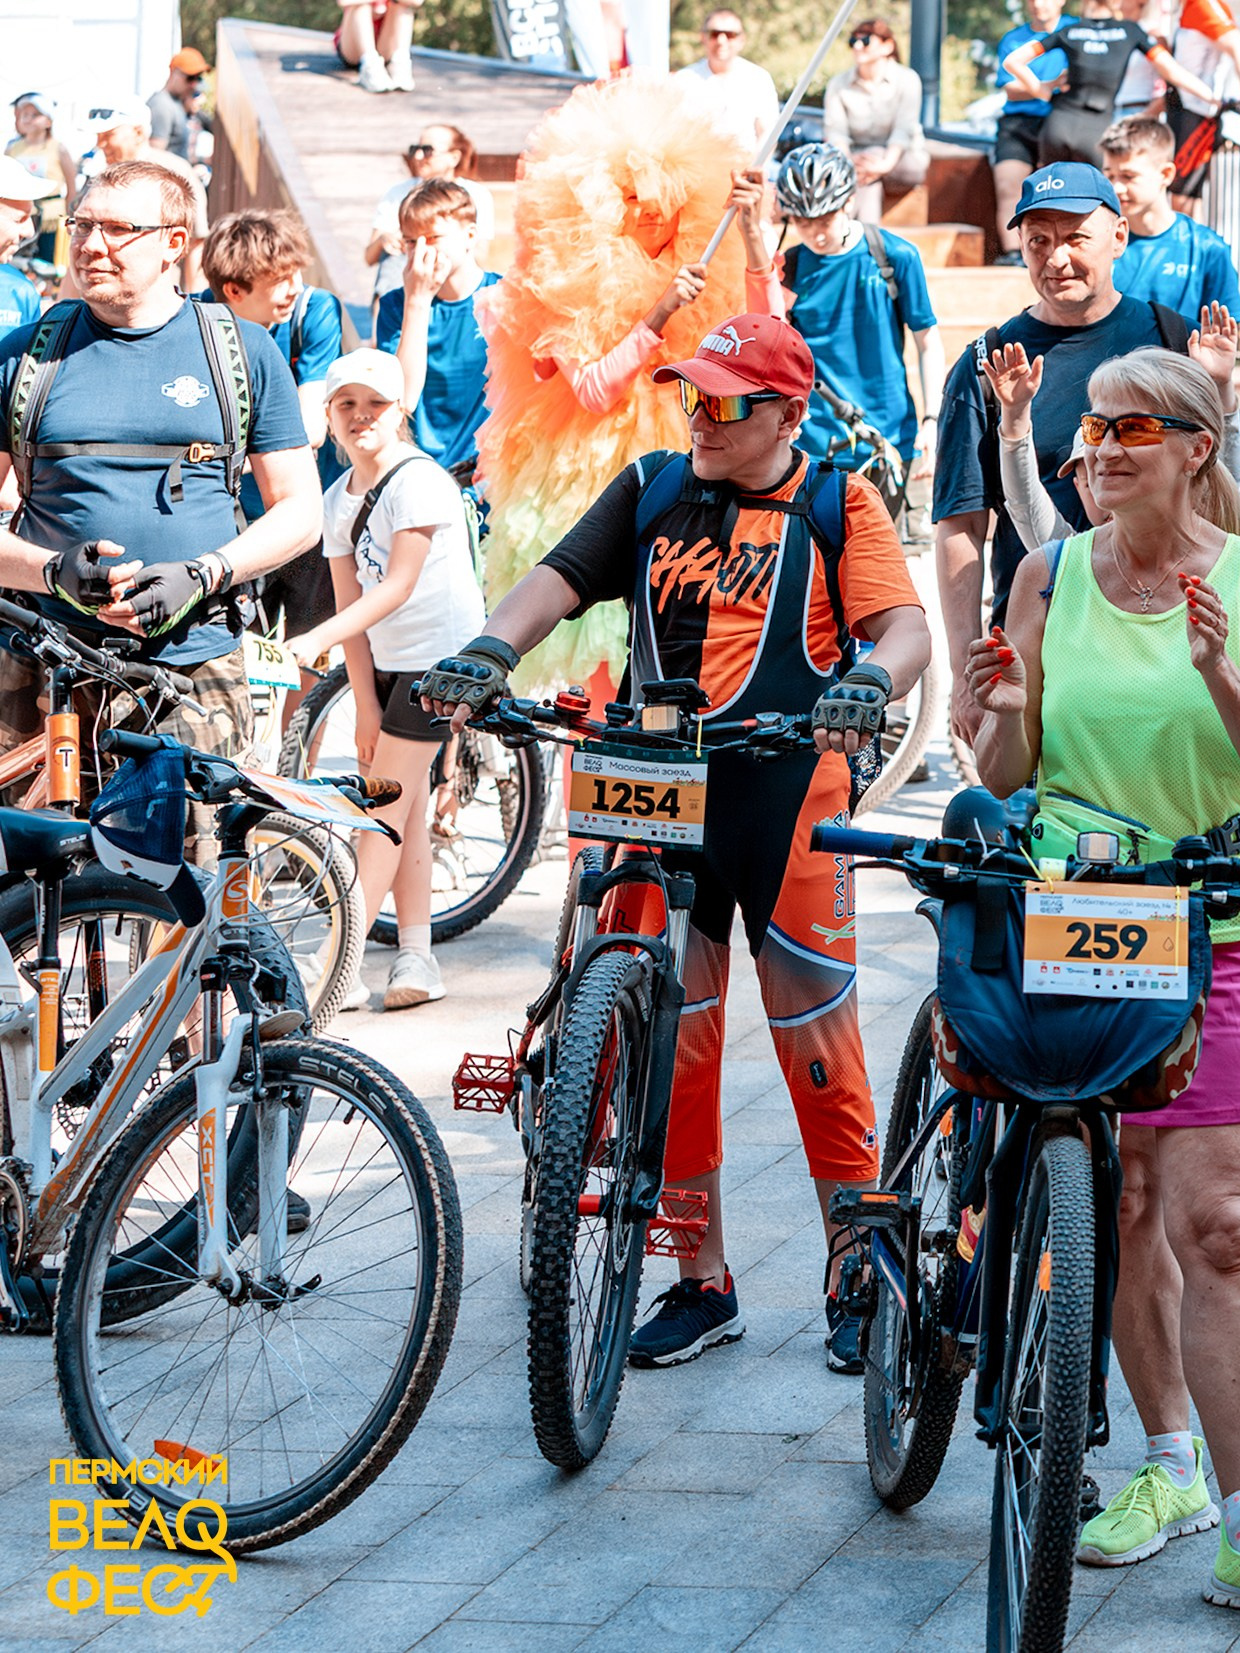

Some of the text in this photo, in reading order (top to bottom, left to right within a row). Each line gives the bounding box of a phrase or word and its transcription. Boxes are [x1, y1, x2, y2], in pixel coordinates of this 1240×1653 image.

[1035, 175, 1065, 192] alo
[253, 640, 284, 664] 755
[592, 779, 681, 819] 1254
[59, 833, 87, 846] STELS
[1065, 921, 1148, 960] 259
[299, 1056, 388, 1116] STELS
